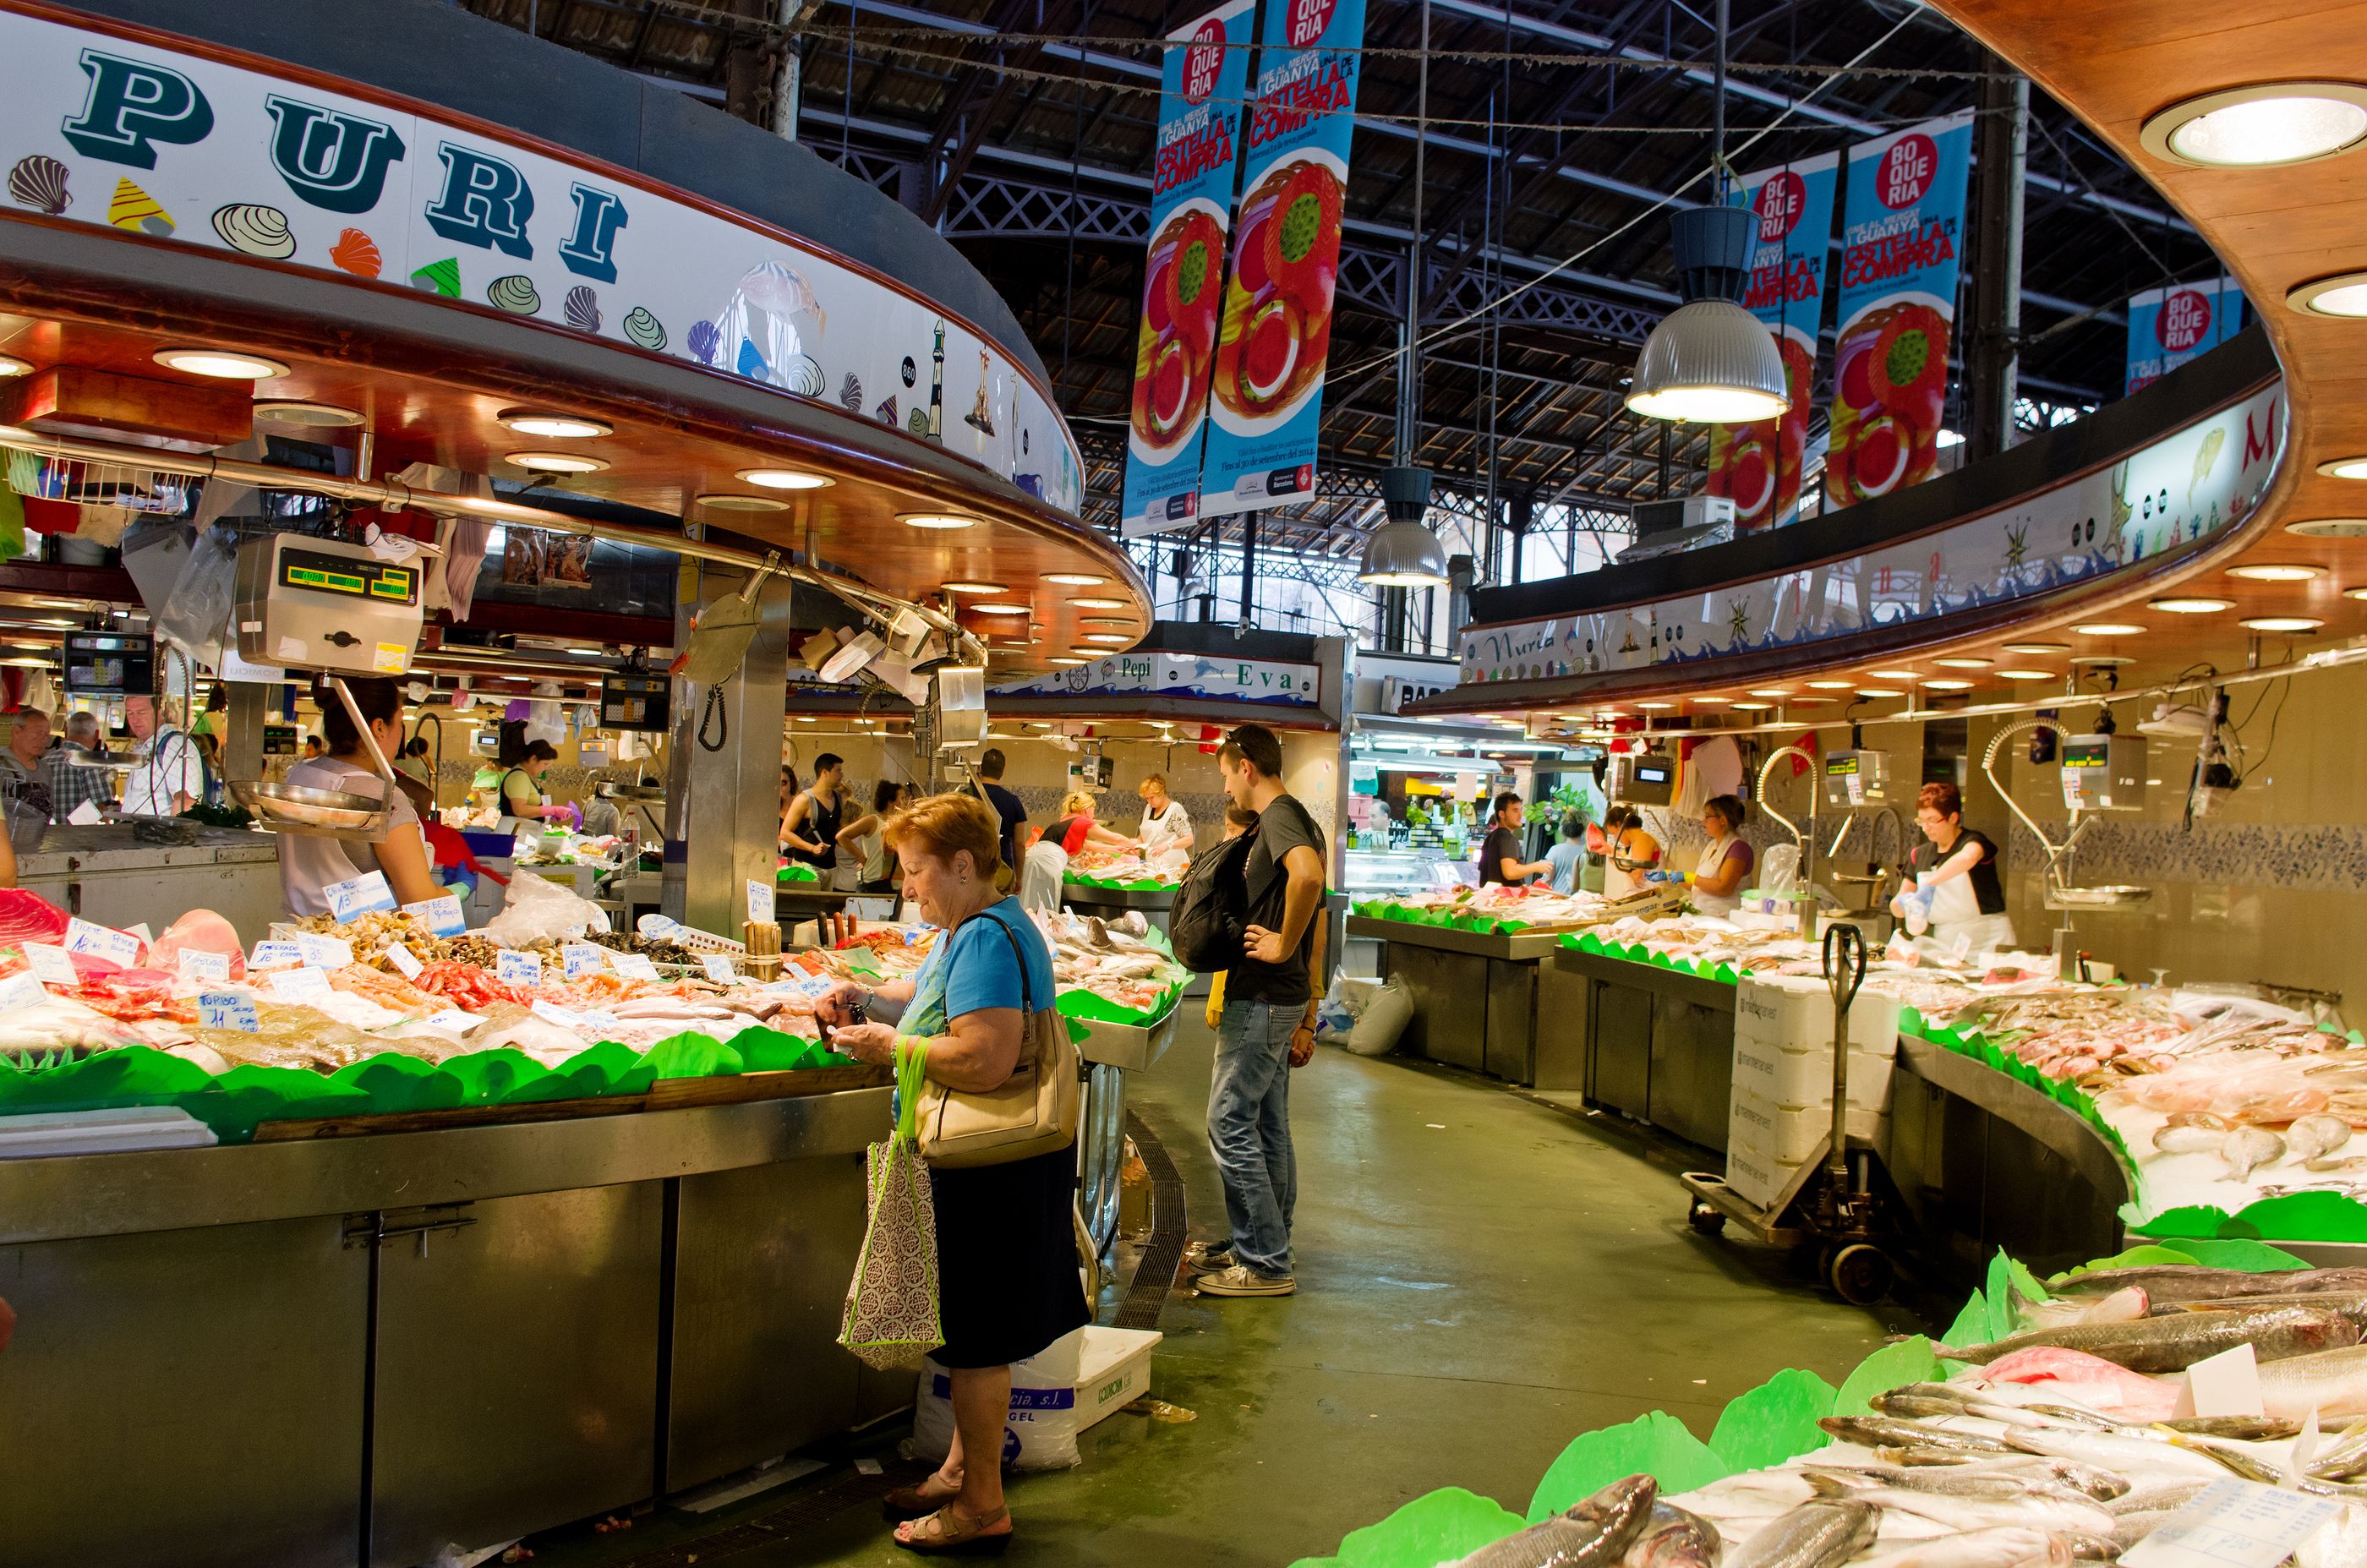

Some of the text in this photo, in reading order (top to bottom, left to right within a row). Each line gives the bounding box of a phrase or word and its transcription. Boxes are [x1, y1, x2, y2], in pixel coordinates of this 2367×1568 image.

[1194, 28, 1214, 56] BO
[1294, 12, 1322, 46] RIA
[1191, 47, 1219, 77] QUE
[1340, 67, 1353, 80] LA
[1342, 54, 1353, 68] DE
[1189, 72, 1211, 96] RIA
[1265, 58, 1320, 95] GUANYA
[1226, 112, 1237, 126] DE
[1250, 79, 1351, 148] COMPRA
[1166, 112, 1209, 145] GUANYA
[1225, 124, 1236, 136] LA
[1156, 118, 1225, 170] CISTELLA
[1891, 140, 1917, 166] BO
[61, 47, 629, 285] PURI
[1154, 135, 1233, 195] COMPRA
[1889, 156, 1928, 186] QUE
[1888, 180, 1920, 206] RIA
[1763, 194, 1798, 220] QUE
[1845, 221, 1944, 265] CISTELLA
[1856, 217, 1921, 245] GUANYA
[1843, 236, 1954, 288] COMPRA
[2168, 295, 2194, 314] BO
[2167, 311, 2202, 331] QUE
[2166, 332, 2195, 349] RIA
[903, 363, 916, 380] 860
[1273, 480, 1293, 489] Barcelona
[1483, 631, 1555, 663] Nuria
[1121, 657, 1151, 683] Pepi
[1236, 663, 1292, 690] Eva
[1040, 1390, 1059, 1406] s.l.
[1009, 1412, 1035, 1422] GEL
